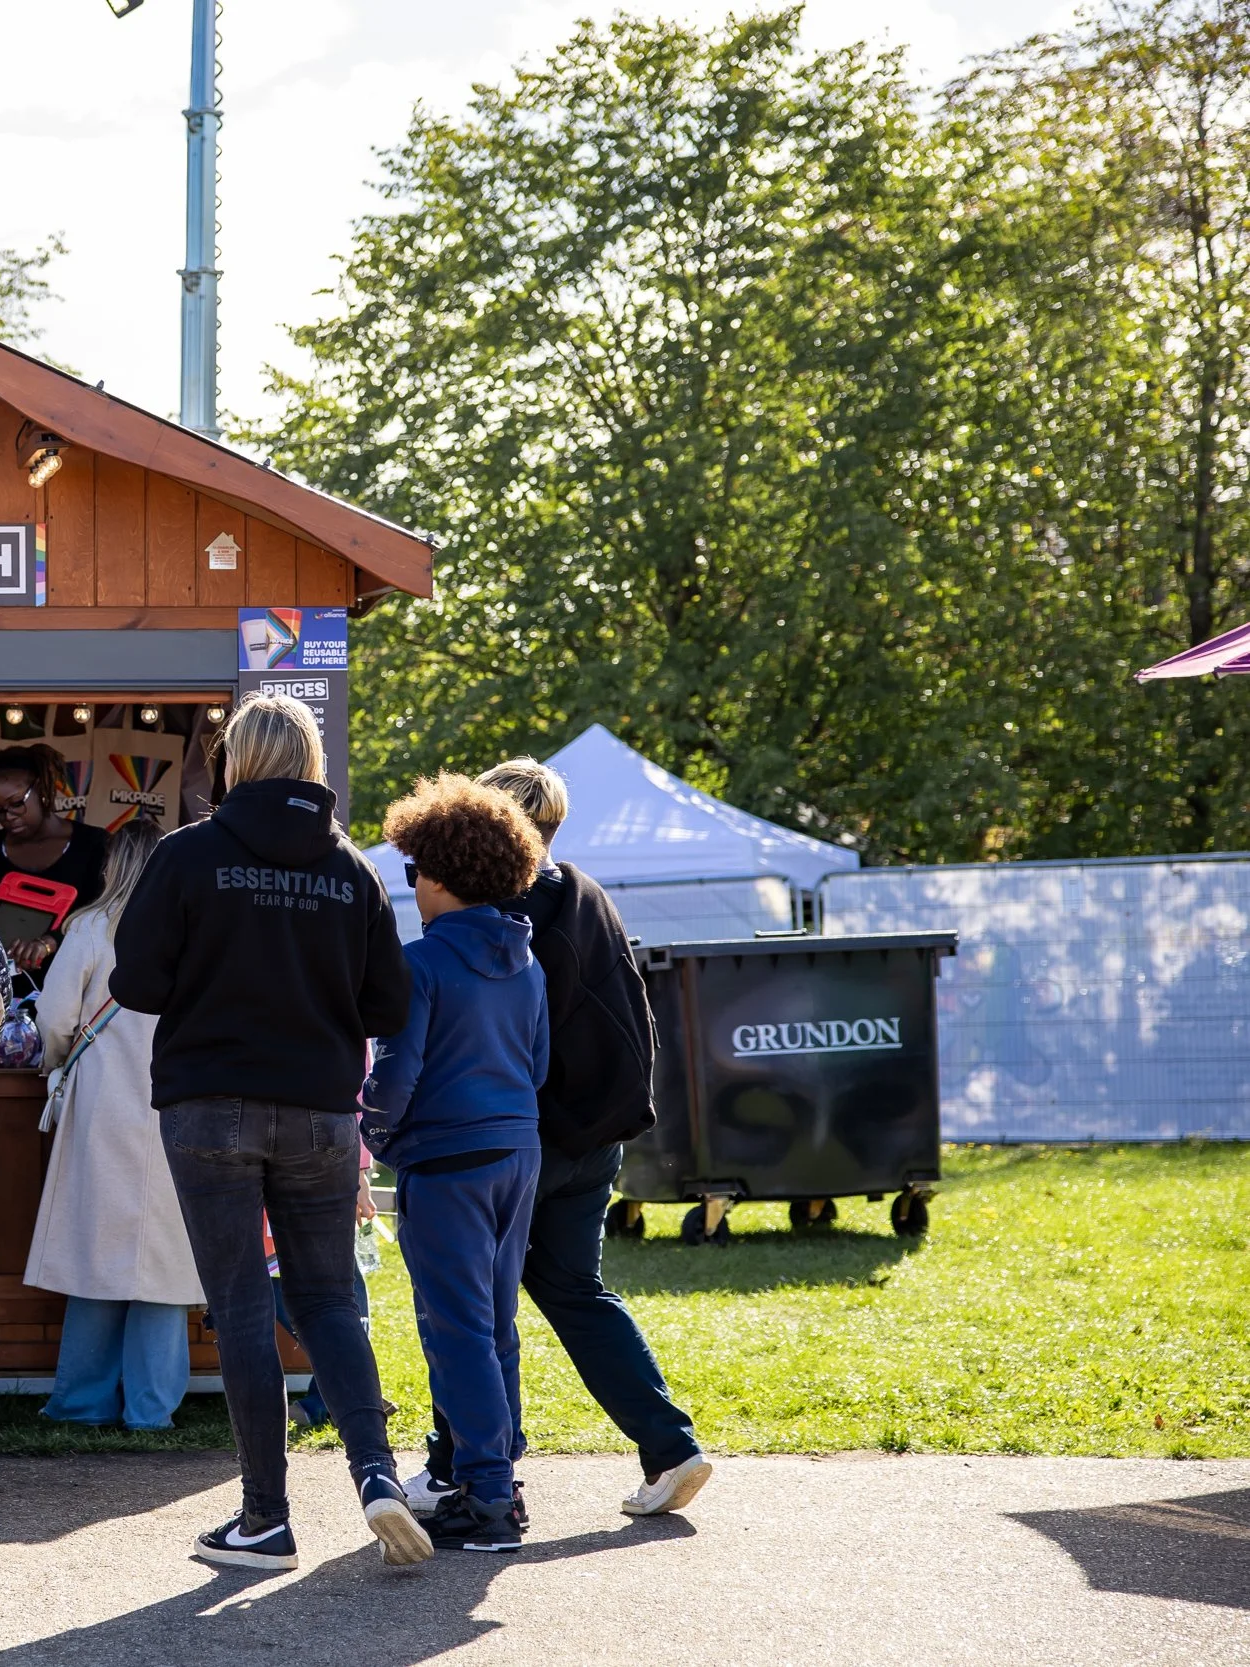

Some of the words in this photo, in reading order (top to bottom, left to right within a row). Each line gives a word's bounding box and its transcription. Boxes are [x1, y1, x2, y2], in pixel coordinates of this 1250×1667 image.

[303, 641, 321, 649] BUY
[322, 640, 347, 649] YOUR
[303, 649, 347, 657] REUSABLE
[302, 657, 321, 665] CUP
[321, 657, 347, 665] HERE!
[263, 682, 326, 698] PRICES
[111, 789, 166, 807] MKPRIDE
[215, 865, 355, 905] ESSENTIALS
[253, 893, 281, 906] FEAR
[284, 895, 295, 908] OF
[298, 898, 319, 912] GOD
[731, 1016, 901, 1052] GRUNDON
